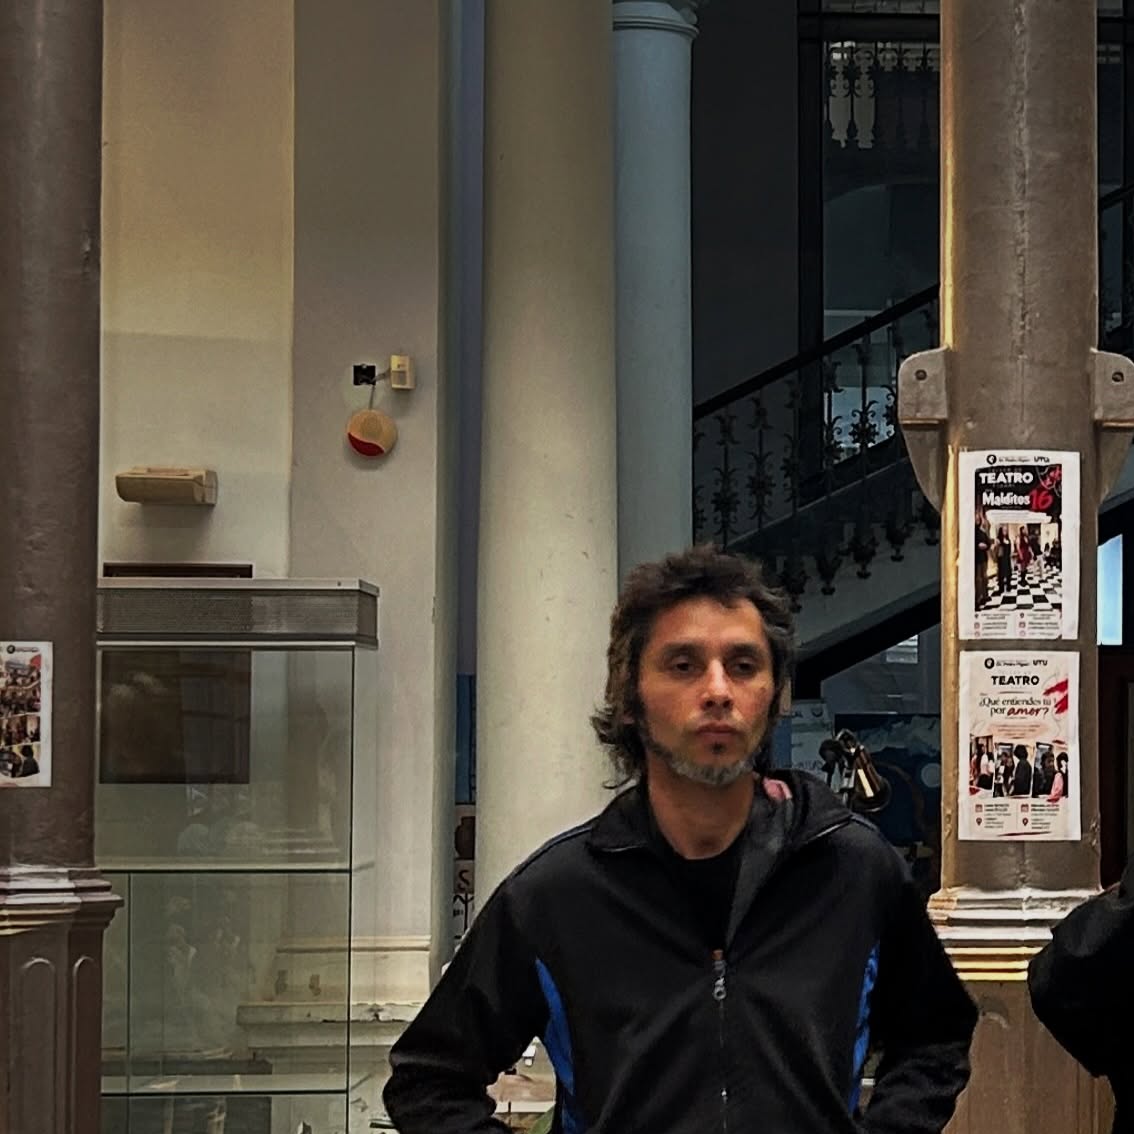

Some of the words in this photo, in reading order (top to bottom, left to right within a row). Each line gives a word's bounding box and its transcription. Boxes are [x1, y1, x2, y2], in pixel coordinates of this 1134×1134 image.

[979, 472, 1034, 484] TEATRO
[982, 492, 1030, 506] Malditos
[1031, 489, 1053, 510] 16
[991, 675, 1040, 686] TEATRO
[990, 707, 1005, 717] por
